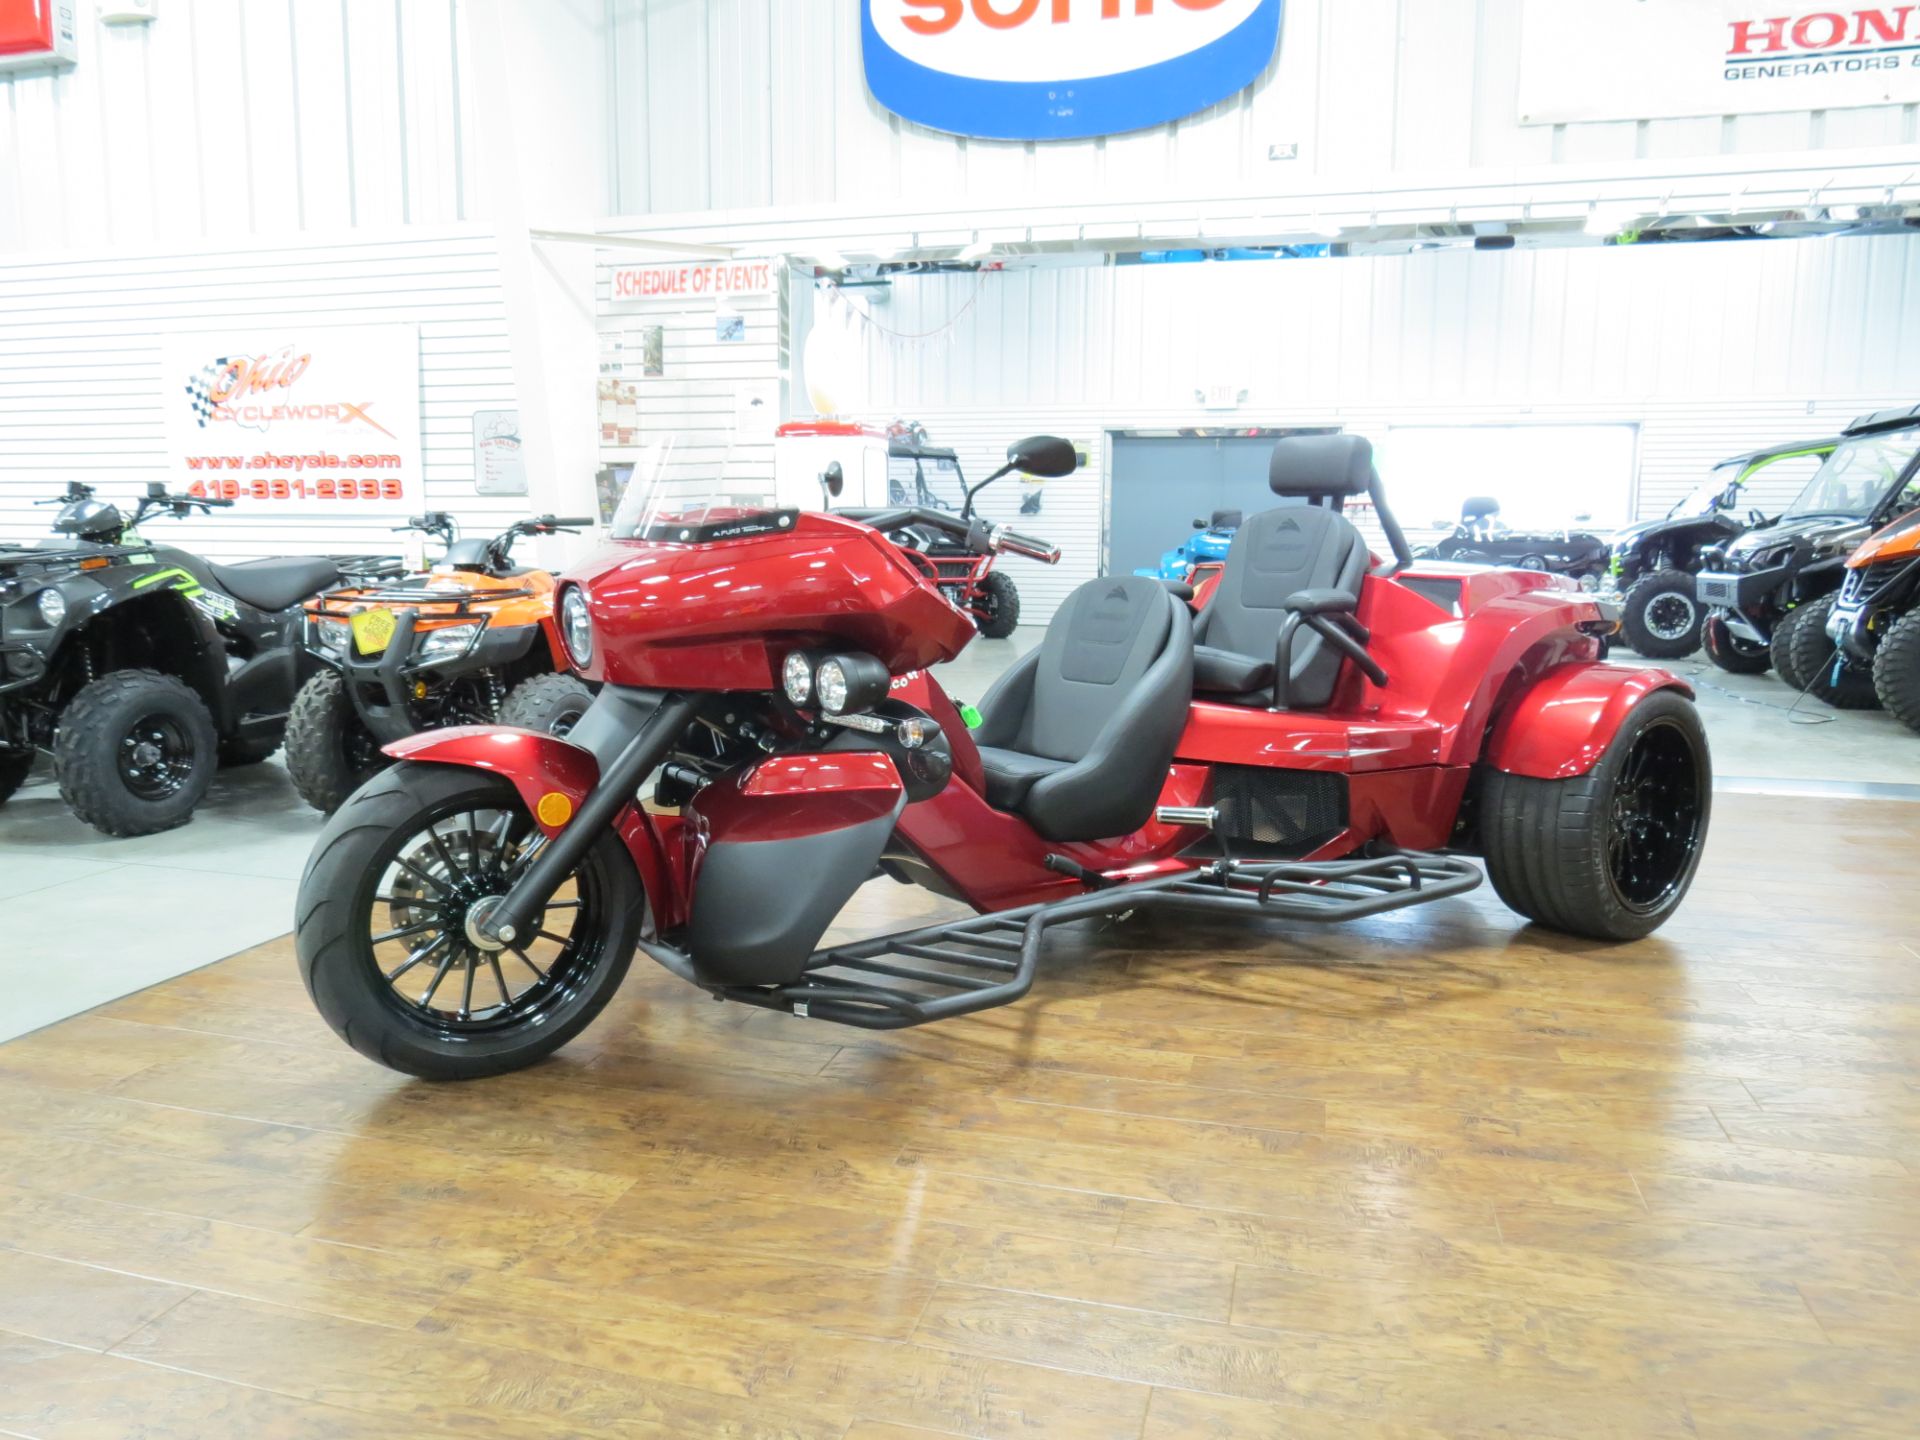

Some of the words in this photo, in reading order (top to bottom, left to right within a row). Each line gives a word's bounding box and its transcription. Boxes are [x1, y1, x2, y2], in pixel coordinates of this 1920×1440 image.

[1725, 6, 1920, 55] HON
[1724, 56, 1900, 81] GENERATORS
[615, 268, 687, 296] SCHEDULE
[692, 266, 712, 293] OF
[715, 264, 768, 292] EVENTS
[210, 350, 312, 403] Ohio
[1210, 384, 1232, 401] EXIT
[184, 450, 401, 472] www.ohcycle.com
[187, 478, 403, 499] 419-331-2333
